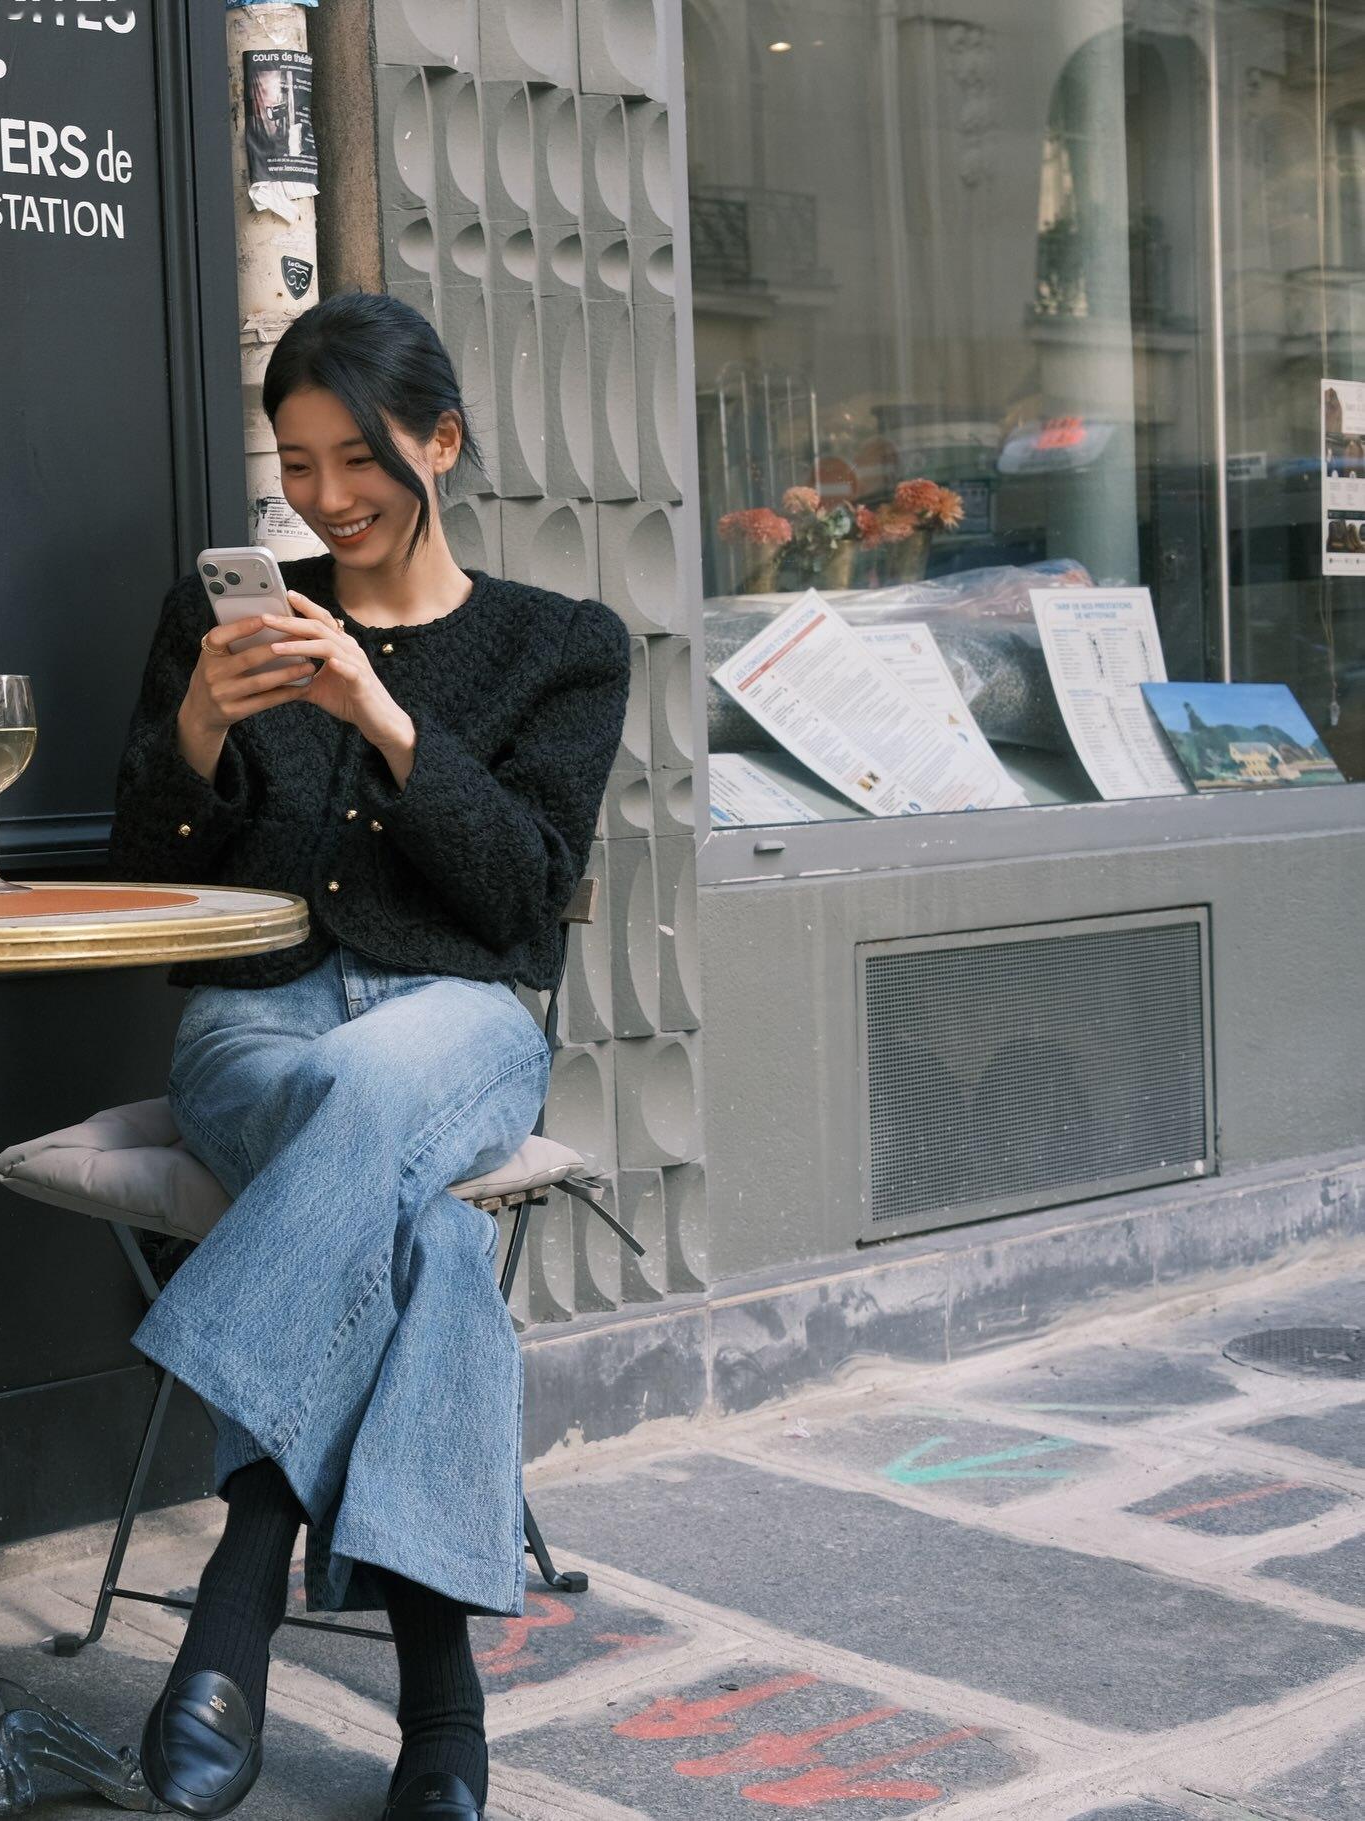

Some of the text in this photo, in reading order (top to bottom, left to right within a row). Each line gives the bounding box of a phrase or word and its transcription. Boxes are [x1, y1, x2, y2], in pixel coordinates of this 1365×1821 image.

[252, 53, 279, 62] cours
[281, 52, 292, 61] de
[97, 130, 132, 183] de
